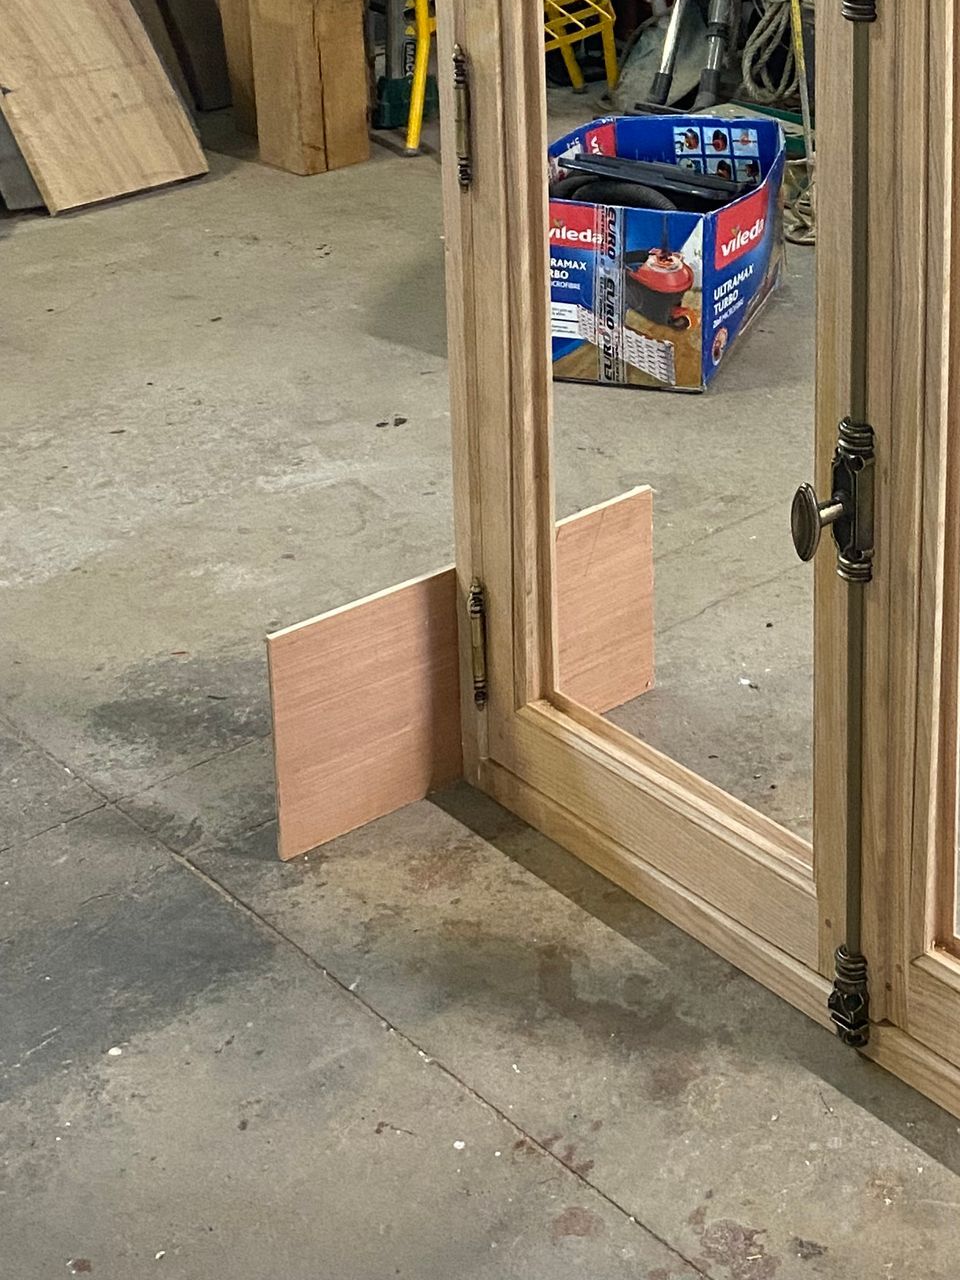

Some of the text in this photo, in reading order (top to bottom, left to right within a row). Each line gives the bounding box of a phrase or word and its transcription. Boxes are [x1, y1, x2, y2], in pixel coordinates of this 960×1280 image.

[549, 226, 603, 243] vileda
[607, 206, 617, 260] EURO
[721, 219, 764, 256] vileda
[550, 257, 587, 271] RAMAX
[550, 269, 569, 280] RBO
[714, 263, 753, 300] ULTRAMAX
[607, 278, 615, 330] EURO
[714, 289, 738, 315] TURBO
[603, 331, 612, 381] EURO
